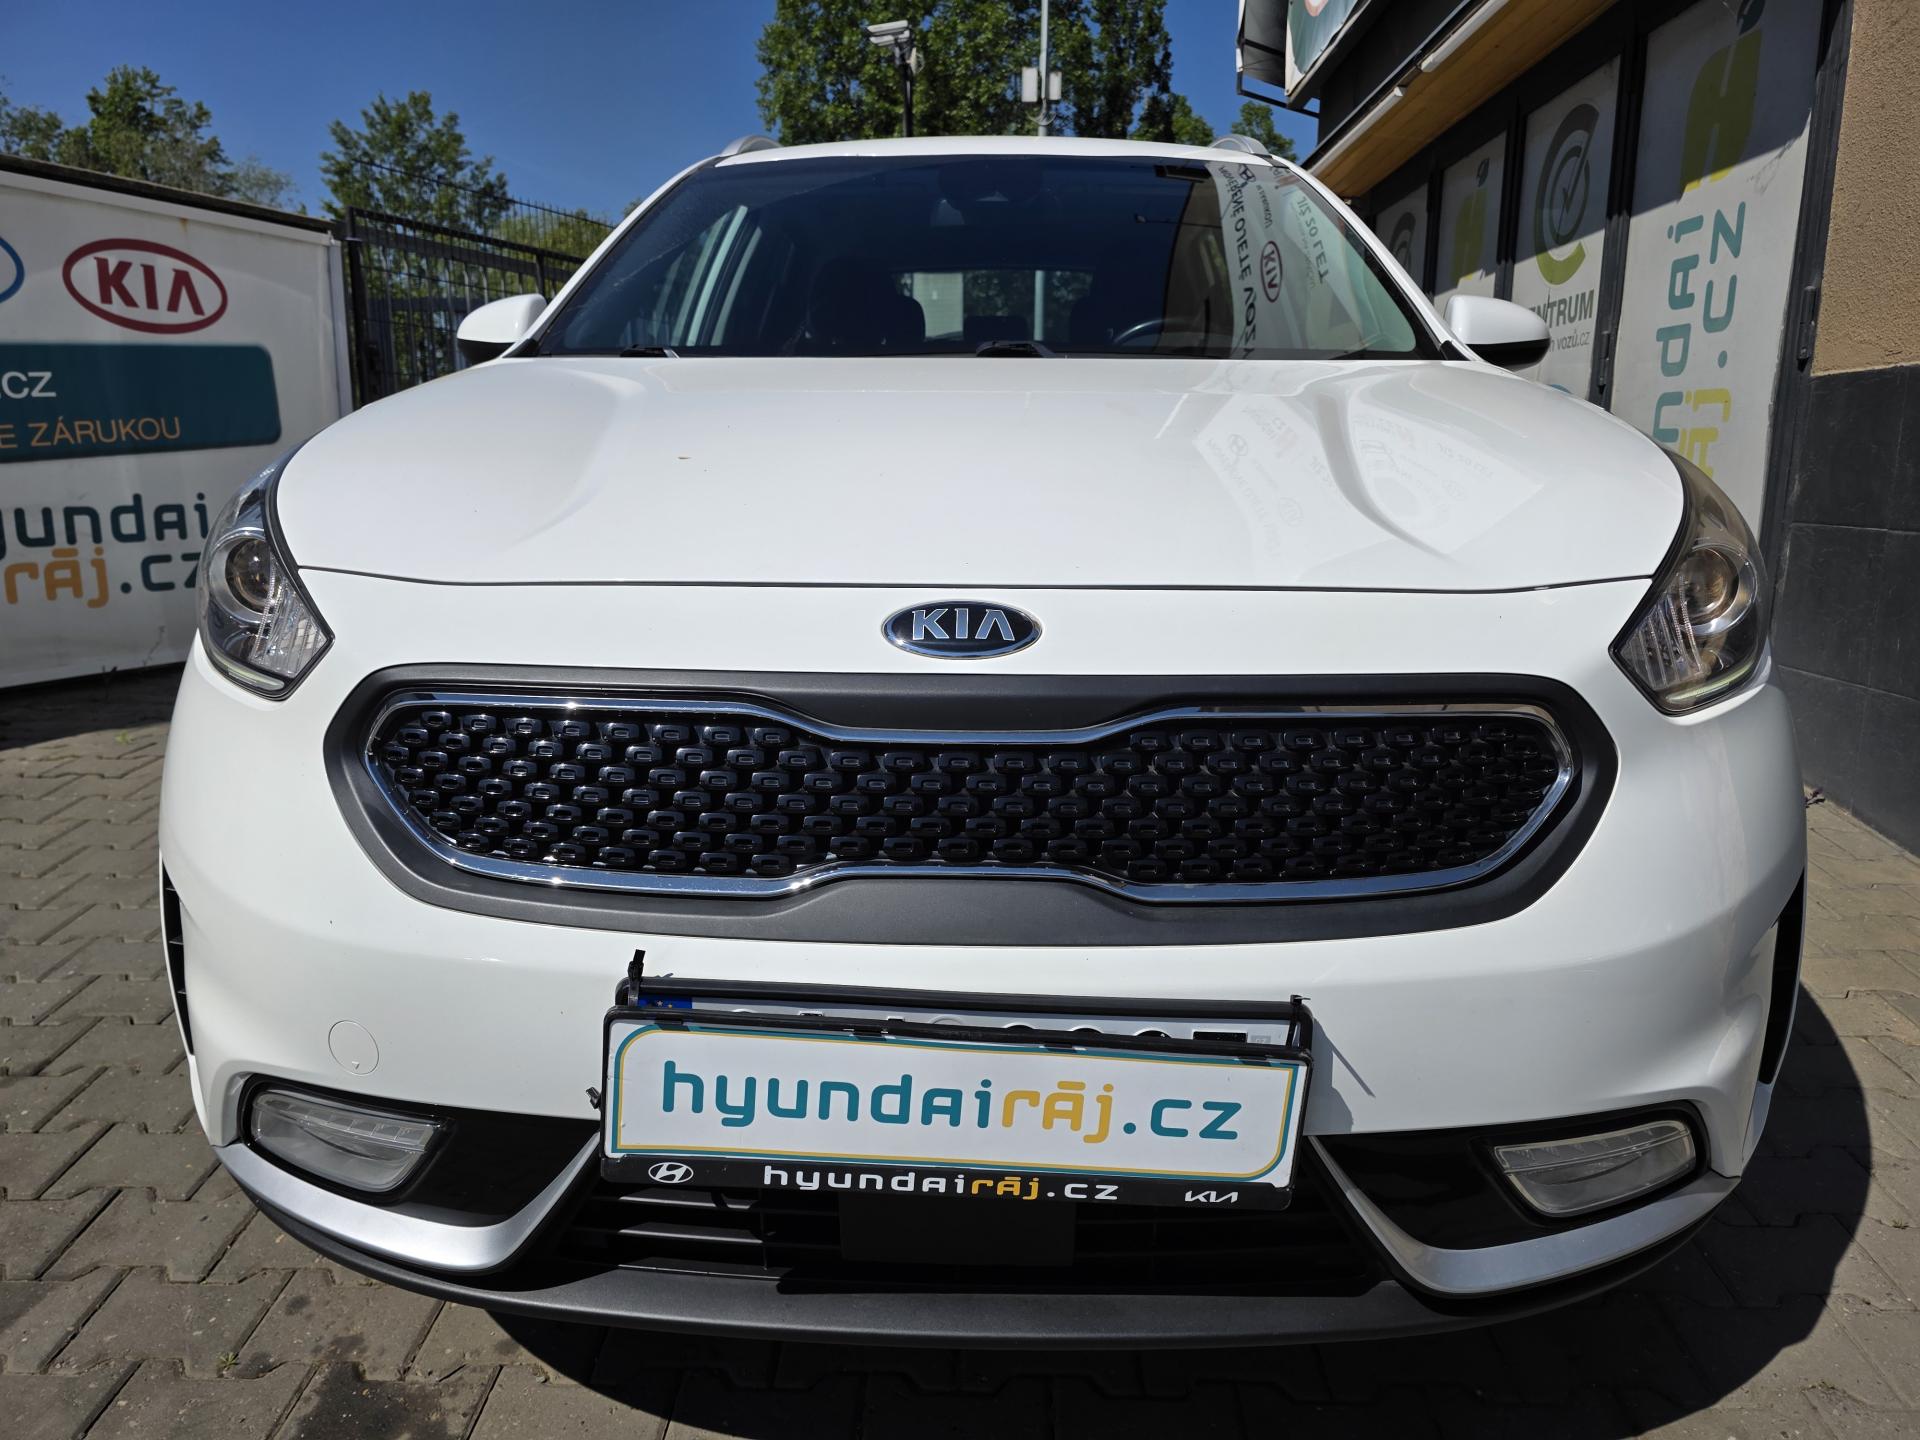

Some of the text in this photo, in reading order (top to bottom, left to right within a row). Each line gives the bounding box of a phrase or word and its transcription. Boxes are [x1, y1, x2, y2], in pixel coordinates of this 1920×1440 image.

[94, 256, 205, 316] KIA
[1529, 289, 1595, 329] NTRUM
[0, 371, 57, 399] CZ
[28, 416, 181, 447] ZÁRUKOU
[0, 492, 209, 561] undai
[912, 608, 1015, 641] KIA
